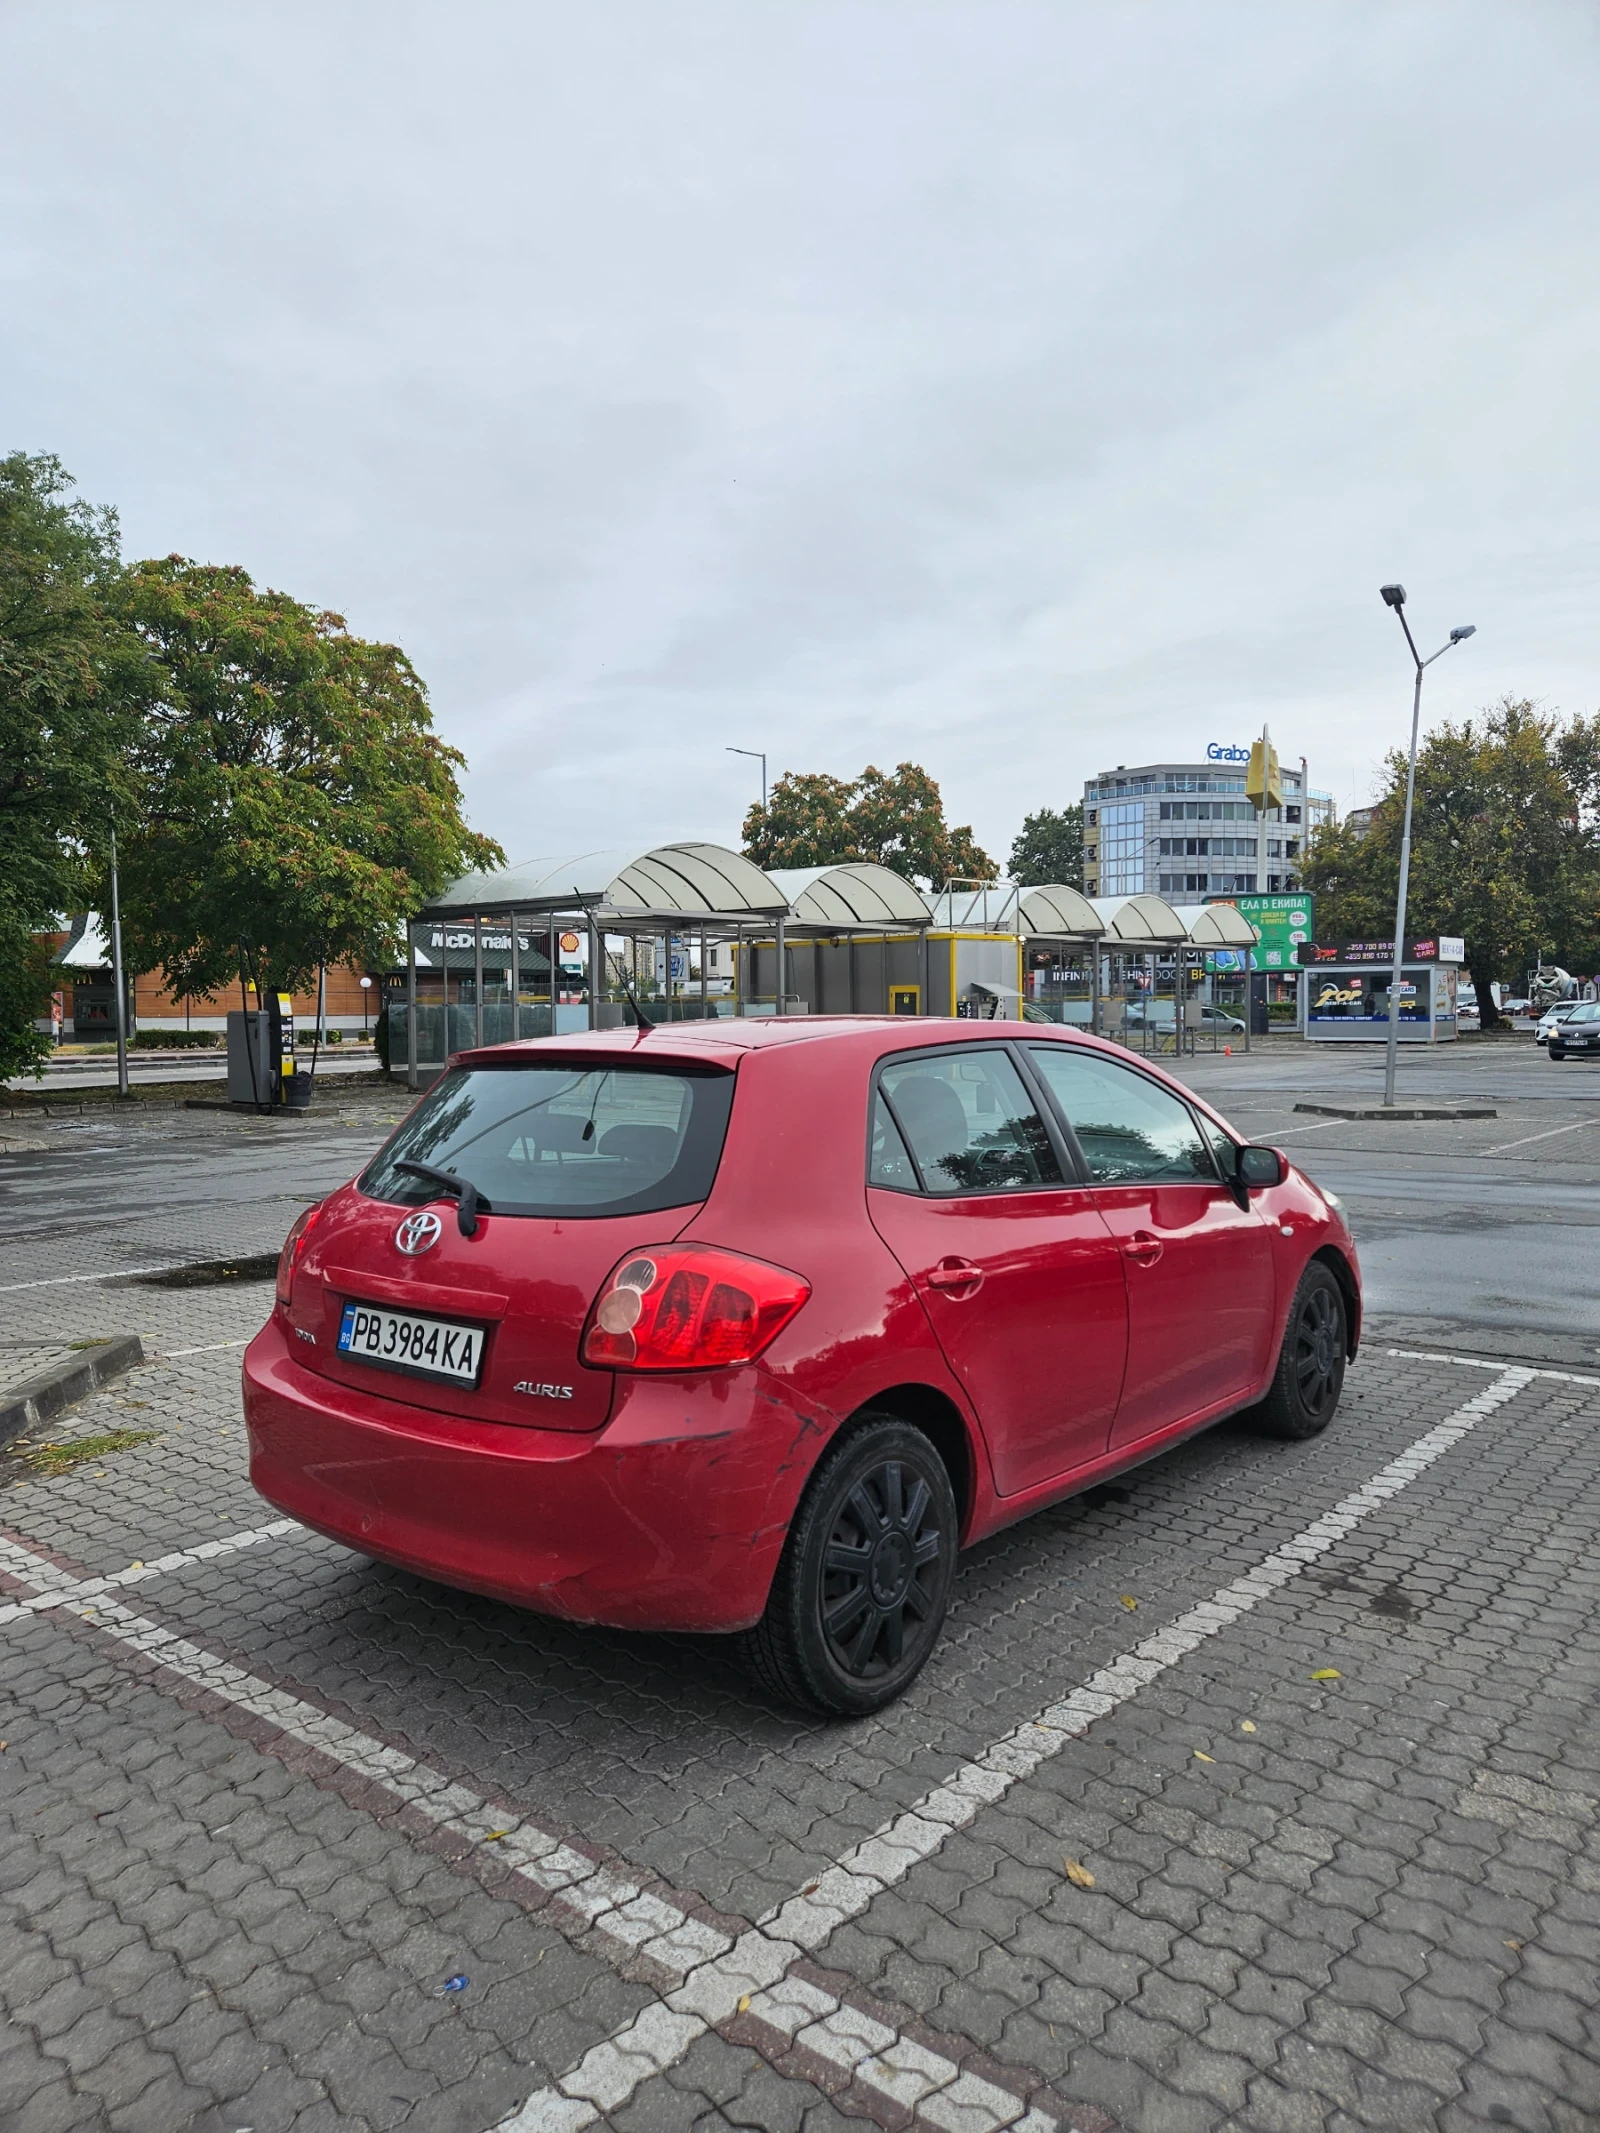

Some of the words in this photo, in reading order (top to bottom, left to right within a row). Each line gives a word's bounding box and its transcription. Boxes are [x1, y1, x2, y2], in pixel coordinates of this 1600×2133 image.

[1207, 743, 1251, 761] Grabo
[1241, 900, 1259, 909] ЕЛА
[1263, 899, 1269, 909] В
[1272, 898, 1306, 908] ЕКИПА!
[1315, 989, 1362, 1007] TOP
[341, 1332, 350, 1344] BG
[513, 1381, 573, 1399] AURIS
